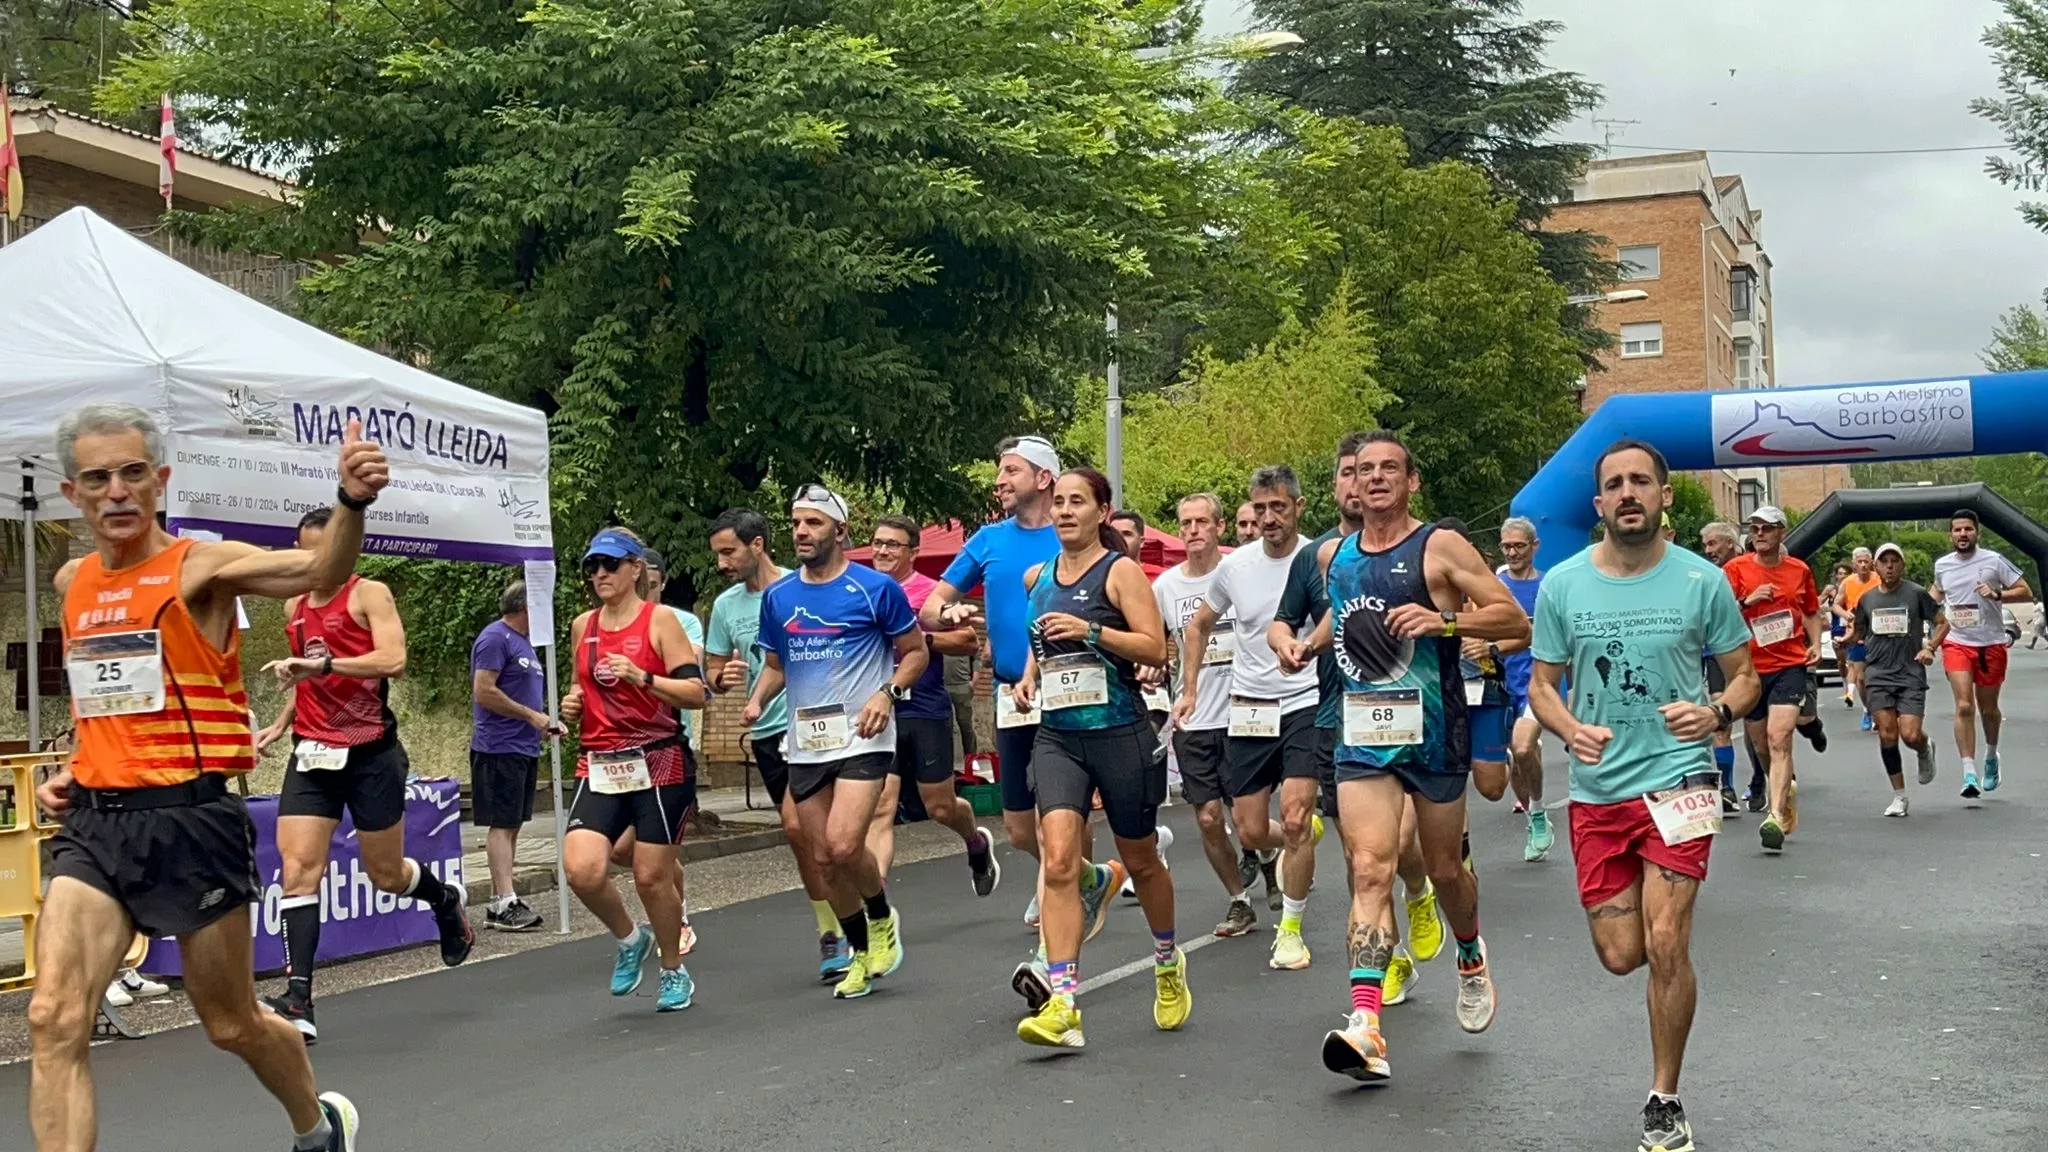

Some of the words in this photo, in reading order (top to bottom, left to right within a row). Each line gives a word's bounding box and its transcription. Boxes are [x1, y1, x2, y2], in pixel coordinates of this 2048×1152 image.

[1837, 391, 1879, 405] Club
[1884, 387, 1964, 402] Atletismo
[1839, 402, 1964, 427] Barbastro
[426, 418, 508, 469] LLEIDA
[291, 463, 324, 480] Marató
[177, 490, 221, 506] DISSABTE
[395, 510, 430, 525] Infantils
[1575, 622, 1596, 632] RUTA
[1598, 620, 1621, 630] VINO
[1624, 616, 1683, 628] SOMONTANO
[788, 637, 804, 648] Club
[789, 647, 843, 662] Barbastro
[96, 662, 122, 682] 25
[1061, 671, 1080, 685] 67
[1250, 708, 1258, 719] 7
[1372, 708, 1394, 721] 68
[811, 720, 826, 732] 10
[603, 763, 636, 776] 1016
[1672, 792, 1716, 815] 1034
